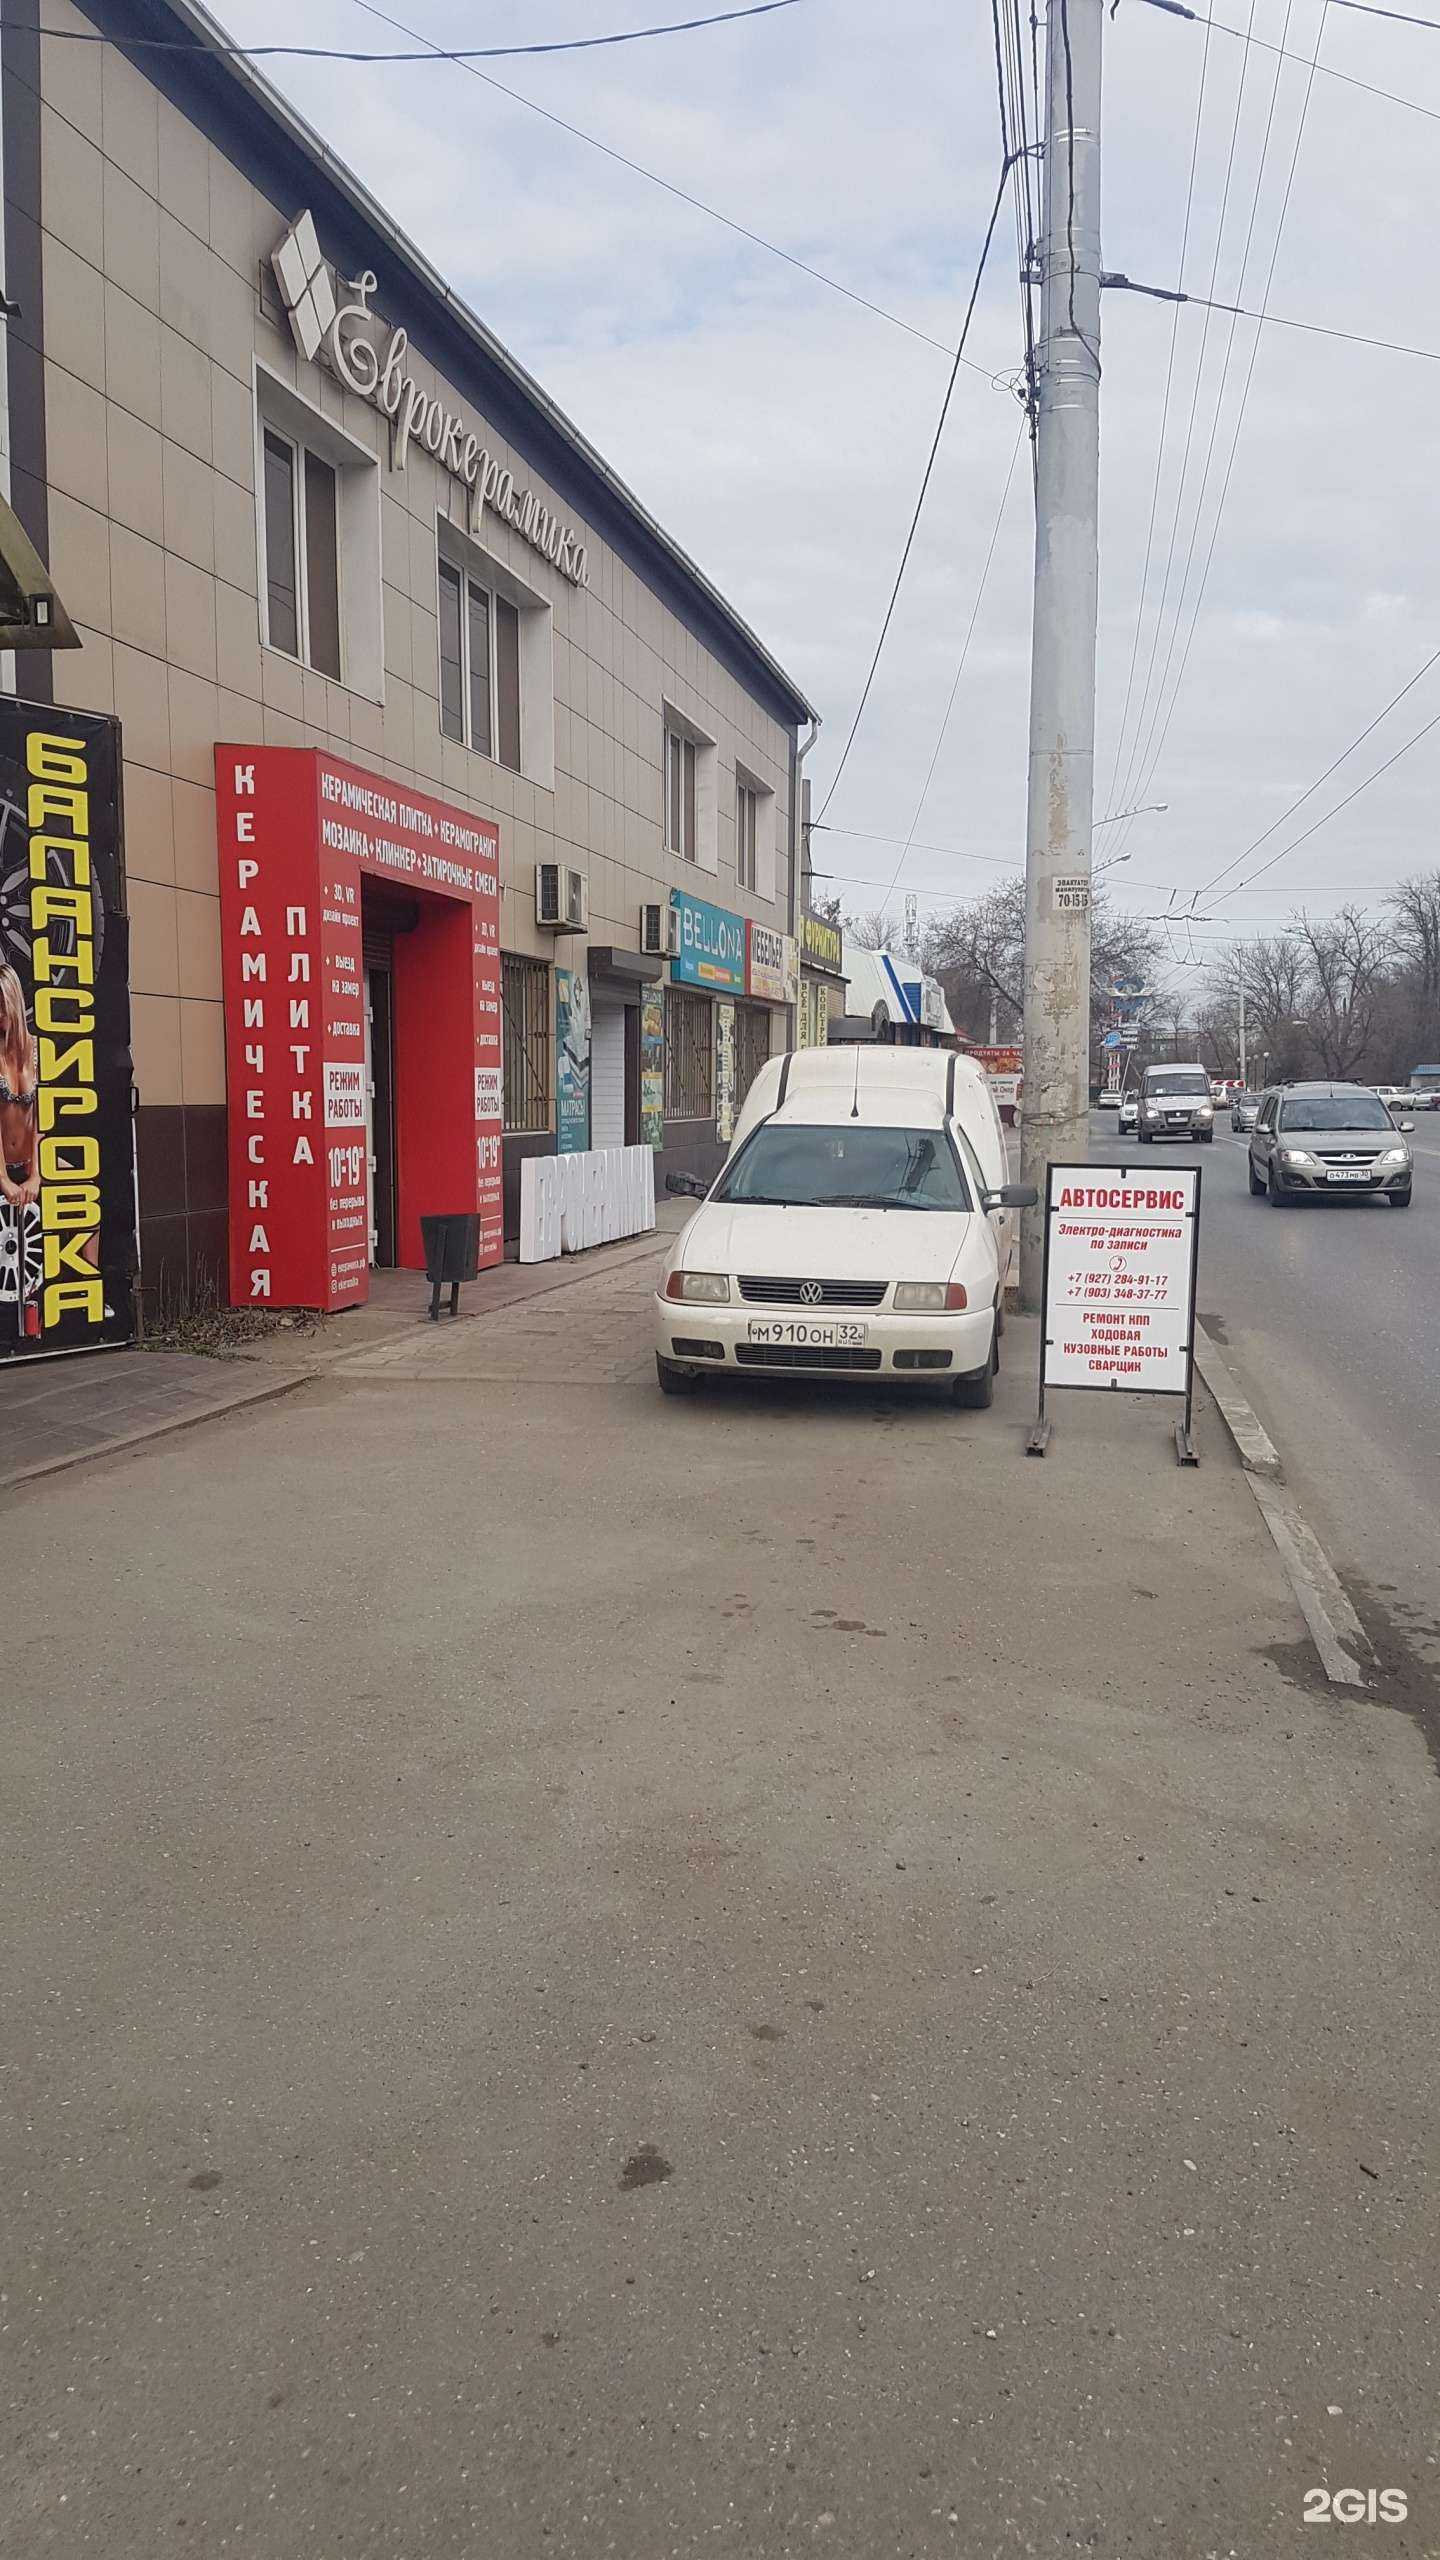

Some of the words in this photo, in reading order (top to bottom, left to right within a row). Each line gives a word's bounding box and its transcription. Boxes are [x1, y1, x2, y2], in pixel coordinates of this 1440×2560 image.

[332, 269, 590, 589] Еврокерамика
[321, 772, 397, 825] КЕРАМИЧЕСКАЯ
[399, 803, 433, 838] ПЛИТКА
[440, 819, 497, 860] КЕРАМОГРАНИТ
[322, 819, 369, 858] МОЗАИКА
[375, 837, 417, 872] КЛИНКЕР
[422, 853, 473, 891] ЗАТИРОЧНЫЕ
[475, 870, 497, 897] СМЕСИ
[683, 907, 743, 963] BELLONA
[26, 731, 105, 1327] БАЛАНСИРОВКА
[233, 763, 272, 1298] КЕРАМИЧЕСКАЯ
[286, 905, 316, 1166] ПЛИТКА
[329, 1070, 360, 1091] РЕЖИМ
[328, 1097, 363, 1119] РАБОТЫ
[1059, 1188, 1184, 1210] АВТОСЕРВИС
[1058, 1223, 1182, 1239] Электро-диагностика
[1090, 1241, 1104, 1249] по
[1107, 1240, 1148, 1251] записи
[1067, 1272, 1082, 1282] +7
[1084, 1273, 1112, 1285] (927)
[1114, 1274, 1168, 1286] 284-91-17
[1067, 1287, 1082, 1297] +7
[1084, 1287, 1111, 1299] (903)
[1113, 1288, 1168, 1300] 348-37-77
[1082, 1312, 1126, 1325] РЕМОНТ
[1129, 1314, 1150, 1326] КПП
[1091, 1328, 1141, 1342] ХОДОВАЯ
[1063, 1343, 1121, 1356] КУЗОВНЫЕ
[1123, 1346, 1168, 1358] РАБОТЫ
[1088, 1359, 1142, 1373] СВАРЩИК
